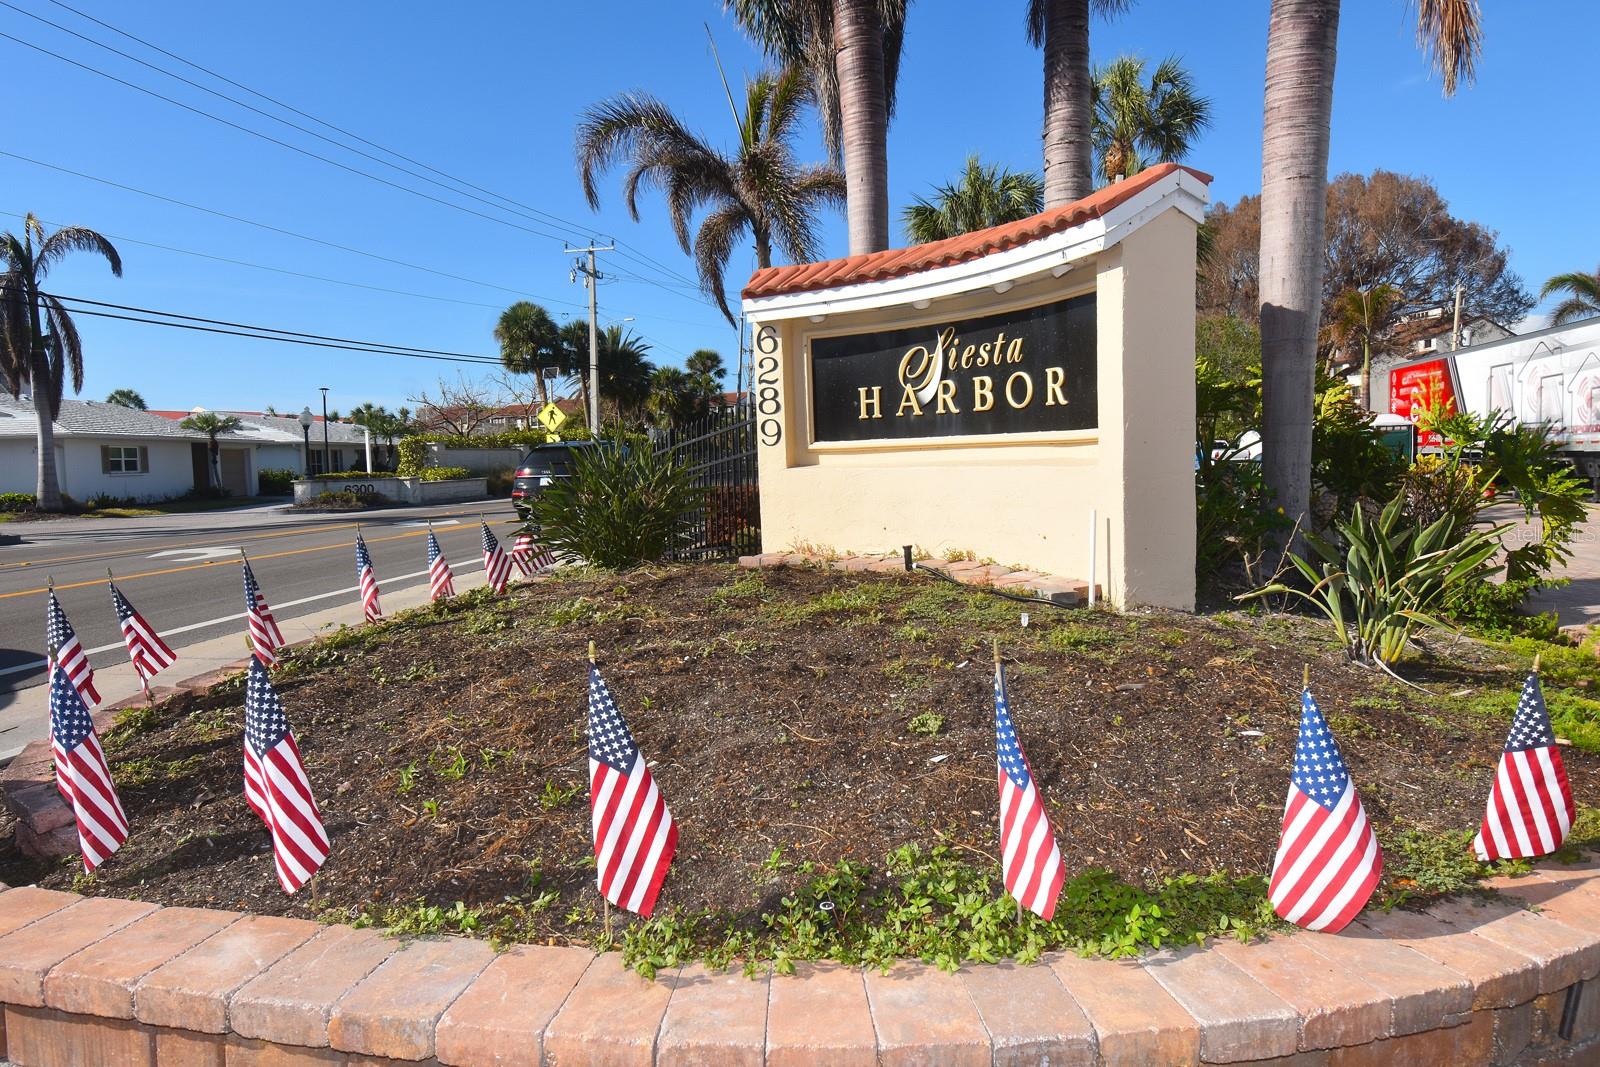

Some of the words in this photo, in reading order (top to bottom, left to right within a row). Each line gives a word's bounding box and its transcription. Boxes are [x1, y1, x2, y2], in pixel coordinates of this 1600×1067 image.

[756, 325, 783, 447] 6289
[897, 326, 1024, 391] Siesta
[857, 366, 1069, 421] HARBOR
[344, 483, 375, 495] 6300
